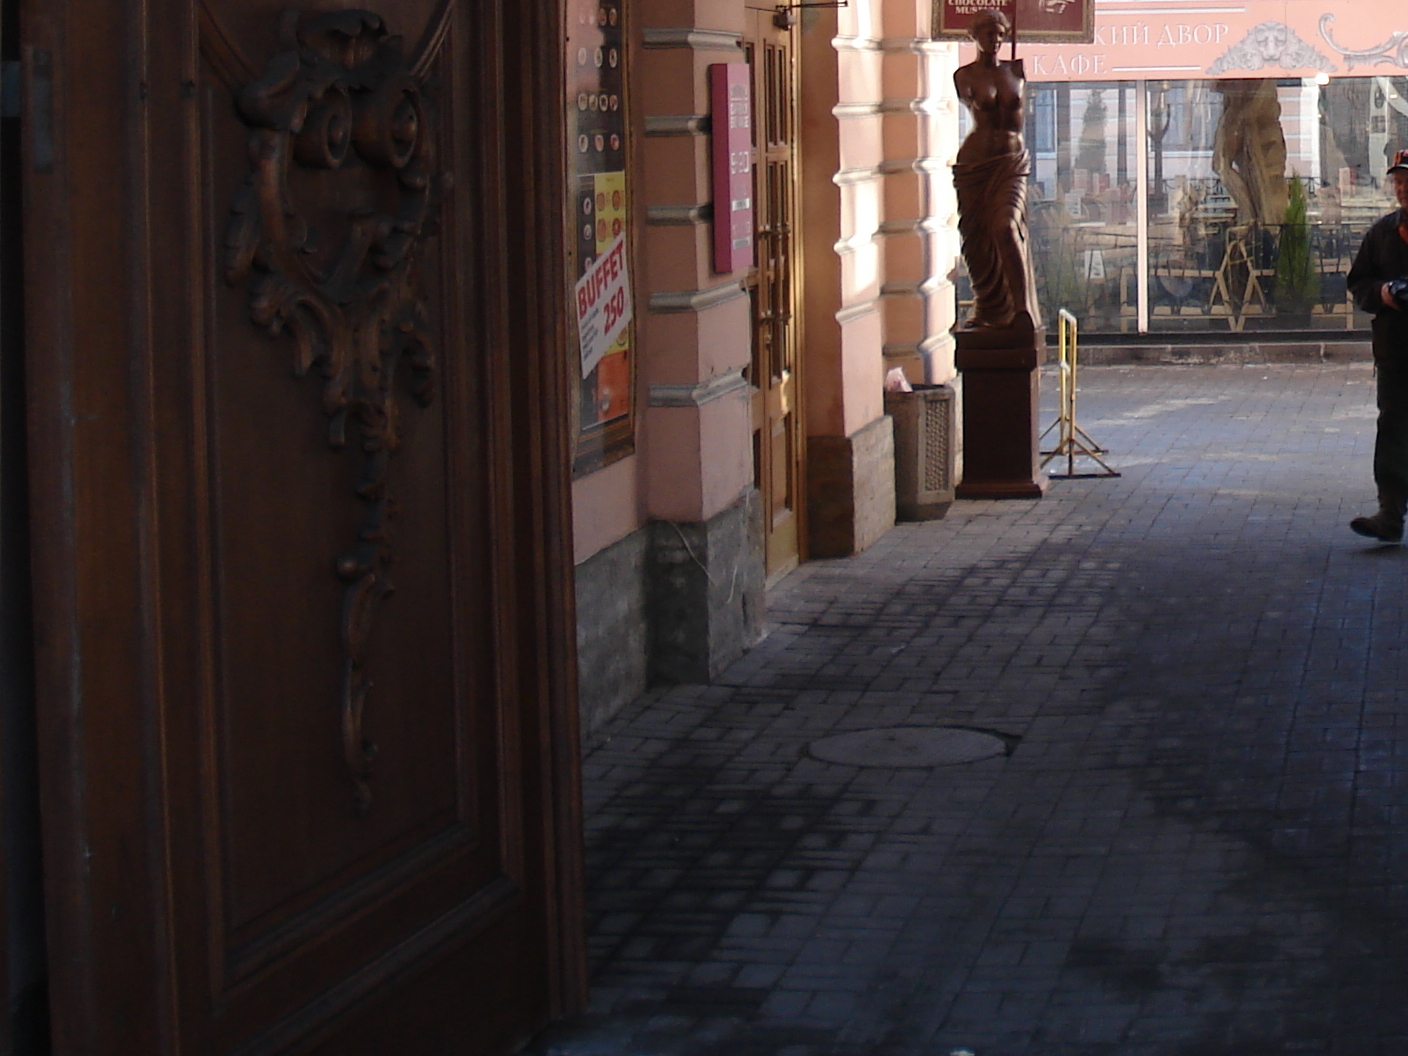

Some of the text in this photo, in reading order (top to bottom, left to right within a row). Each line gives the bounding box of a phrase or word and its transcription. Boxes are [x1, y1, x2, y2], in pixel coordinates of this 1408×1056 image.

[1157, 24, 1229, 48] ДВОР
[1032, 53, 1107, 76] КАФЕ
[578, 239, 624, 320] BUFFET
[603, 286, 625, 336] 250
